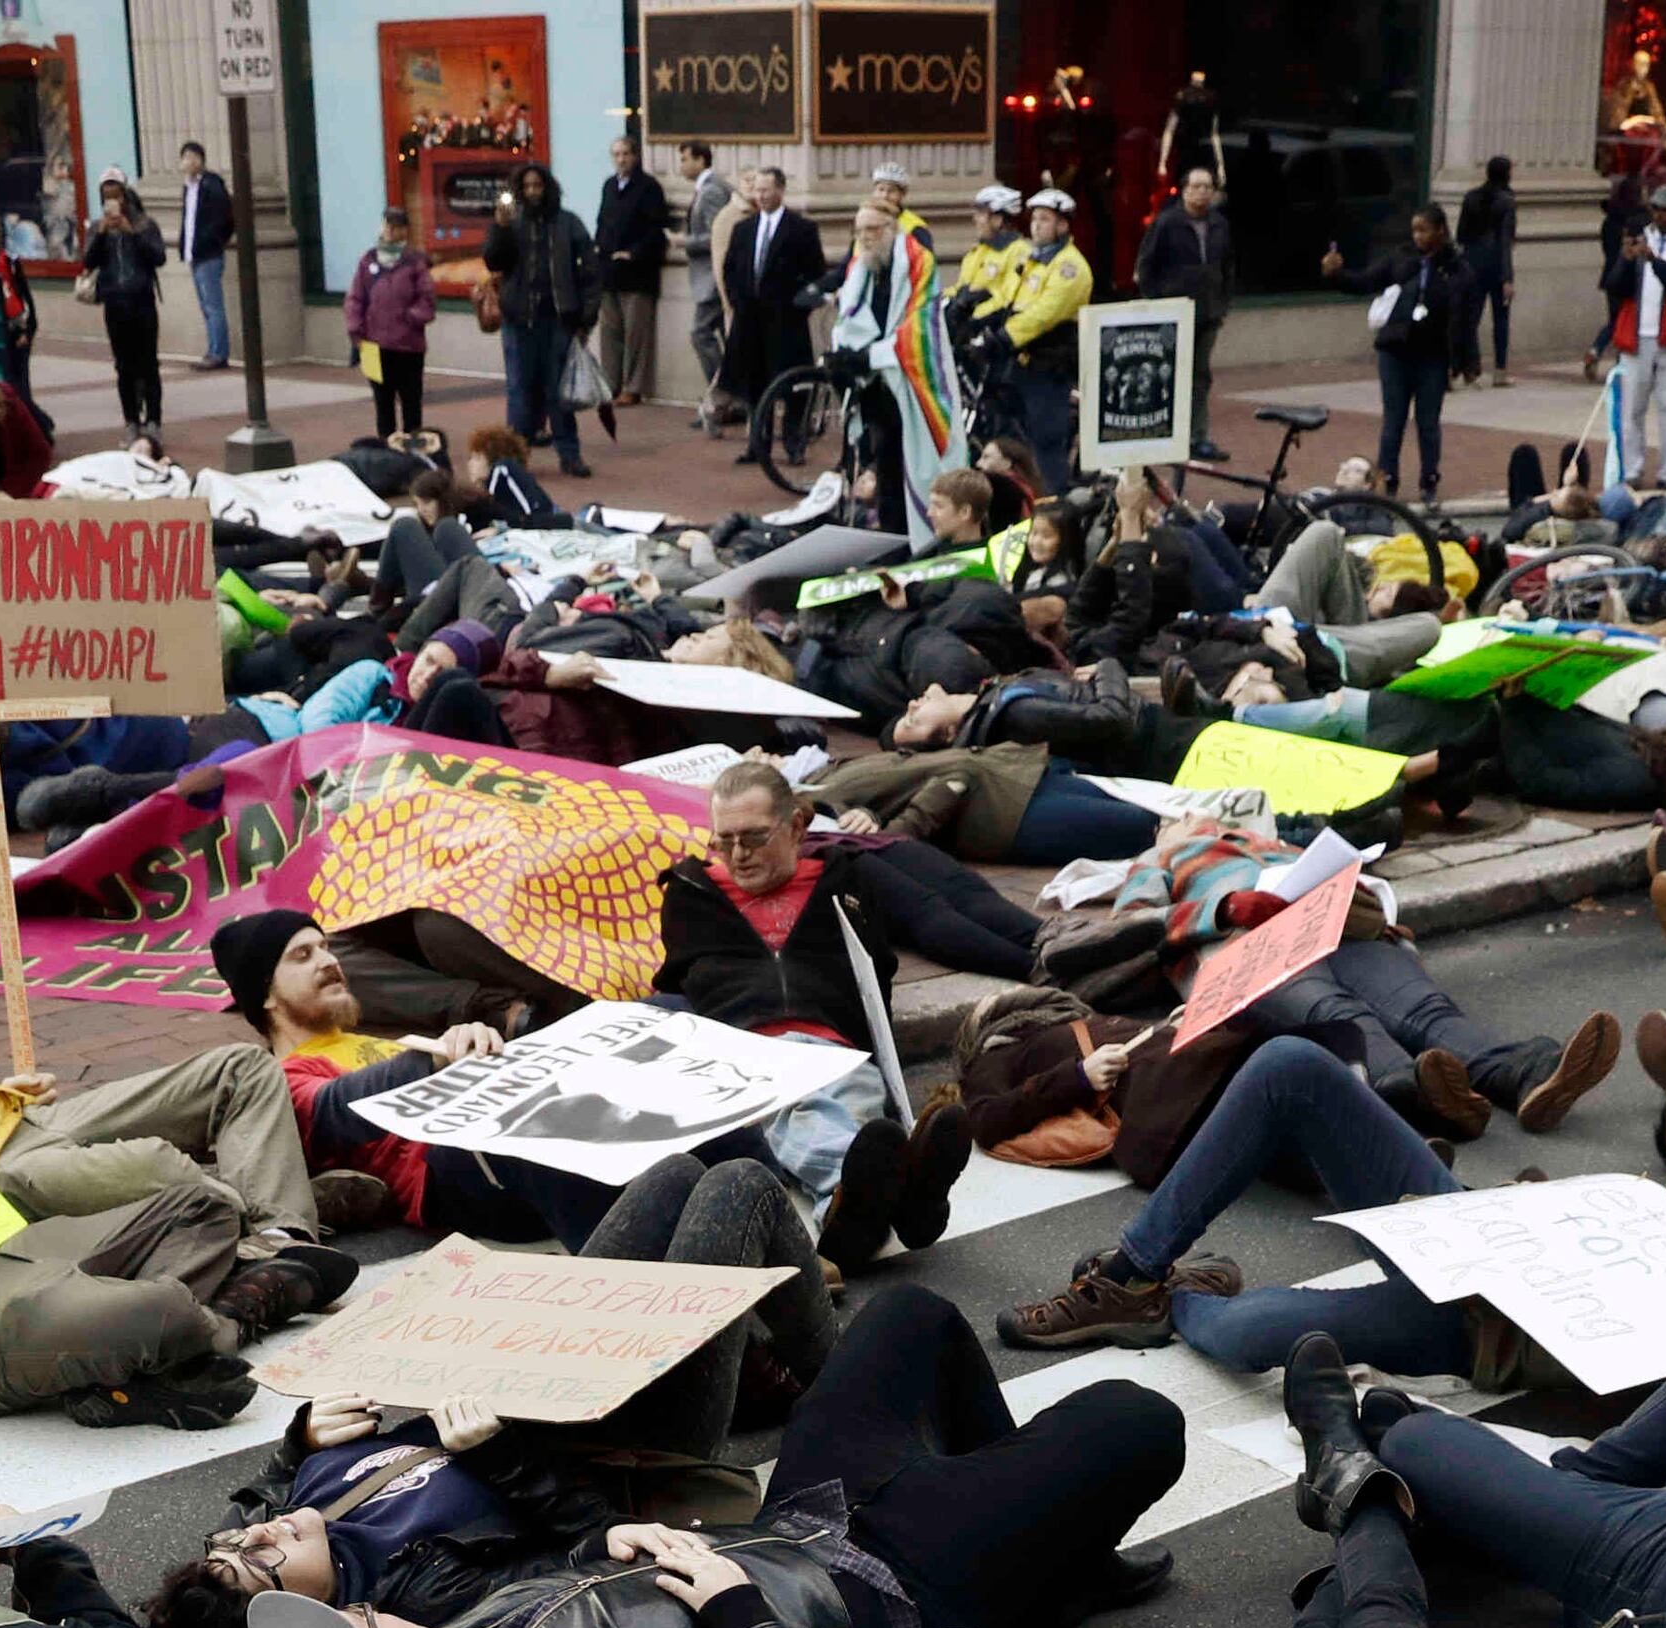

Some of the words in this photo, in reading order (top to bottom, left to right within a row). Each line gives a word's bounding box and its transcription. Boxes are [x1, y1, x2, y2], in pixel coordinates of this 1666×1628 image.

[231, 0, 252, 19] NO
[225, 27, 265, 49] TURN
[220, 57, 241, 79] ON
[244, 56, 271, 78] RED
[678, 43, 790, 106] macy's
[858, 45, 983, 106] macy's
[9, 625, 169, 683] #NODAPL
[73, 914, 225, 955] AL
[579, 1004, 681, 1049] FREE
[373, 1040, 550, 1121] PELTIER
[419, 1043, 595, 1137] LEONARD
[1550, 1210, 1655, 1276] for
[450, 1267, 596, 1308] WELLS
[598, 1279, 748, 1317] FARGO
[378, 1311, 489, 1349] NOW
[492, 1324, 679, 1358] BACKING
